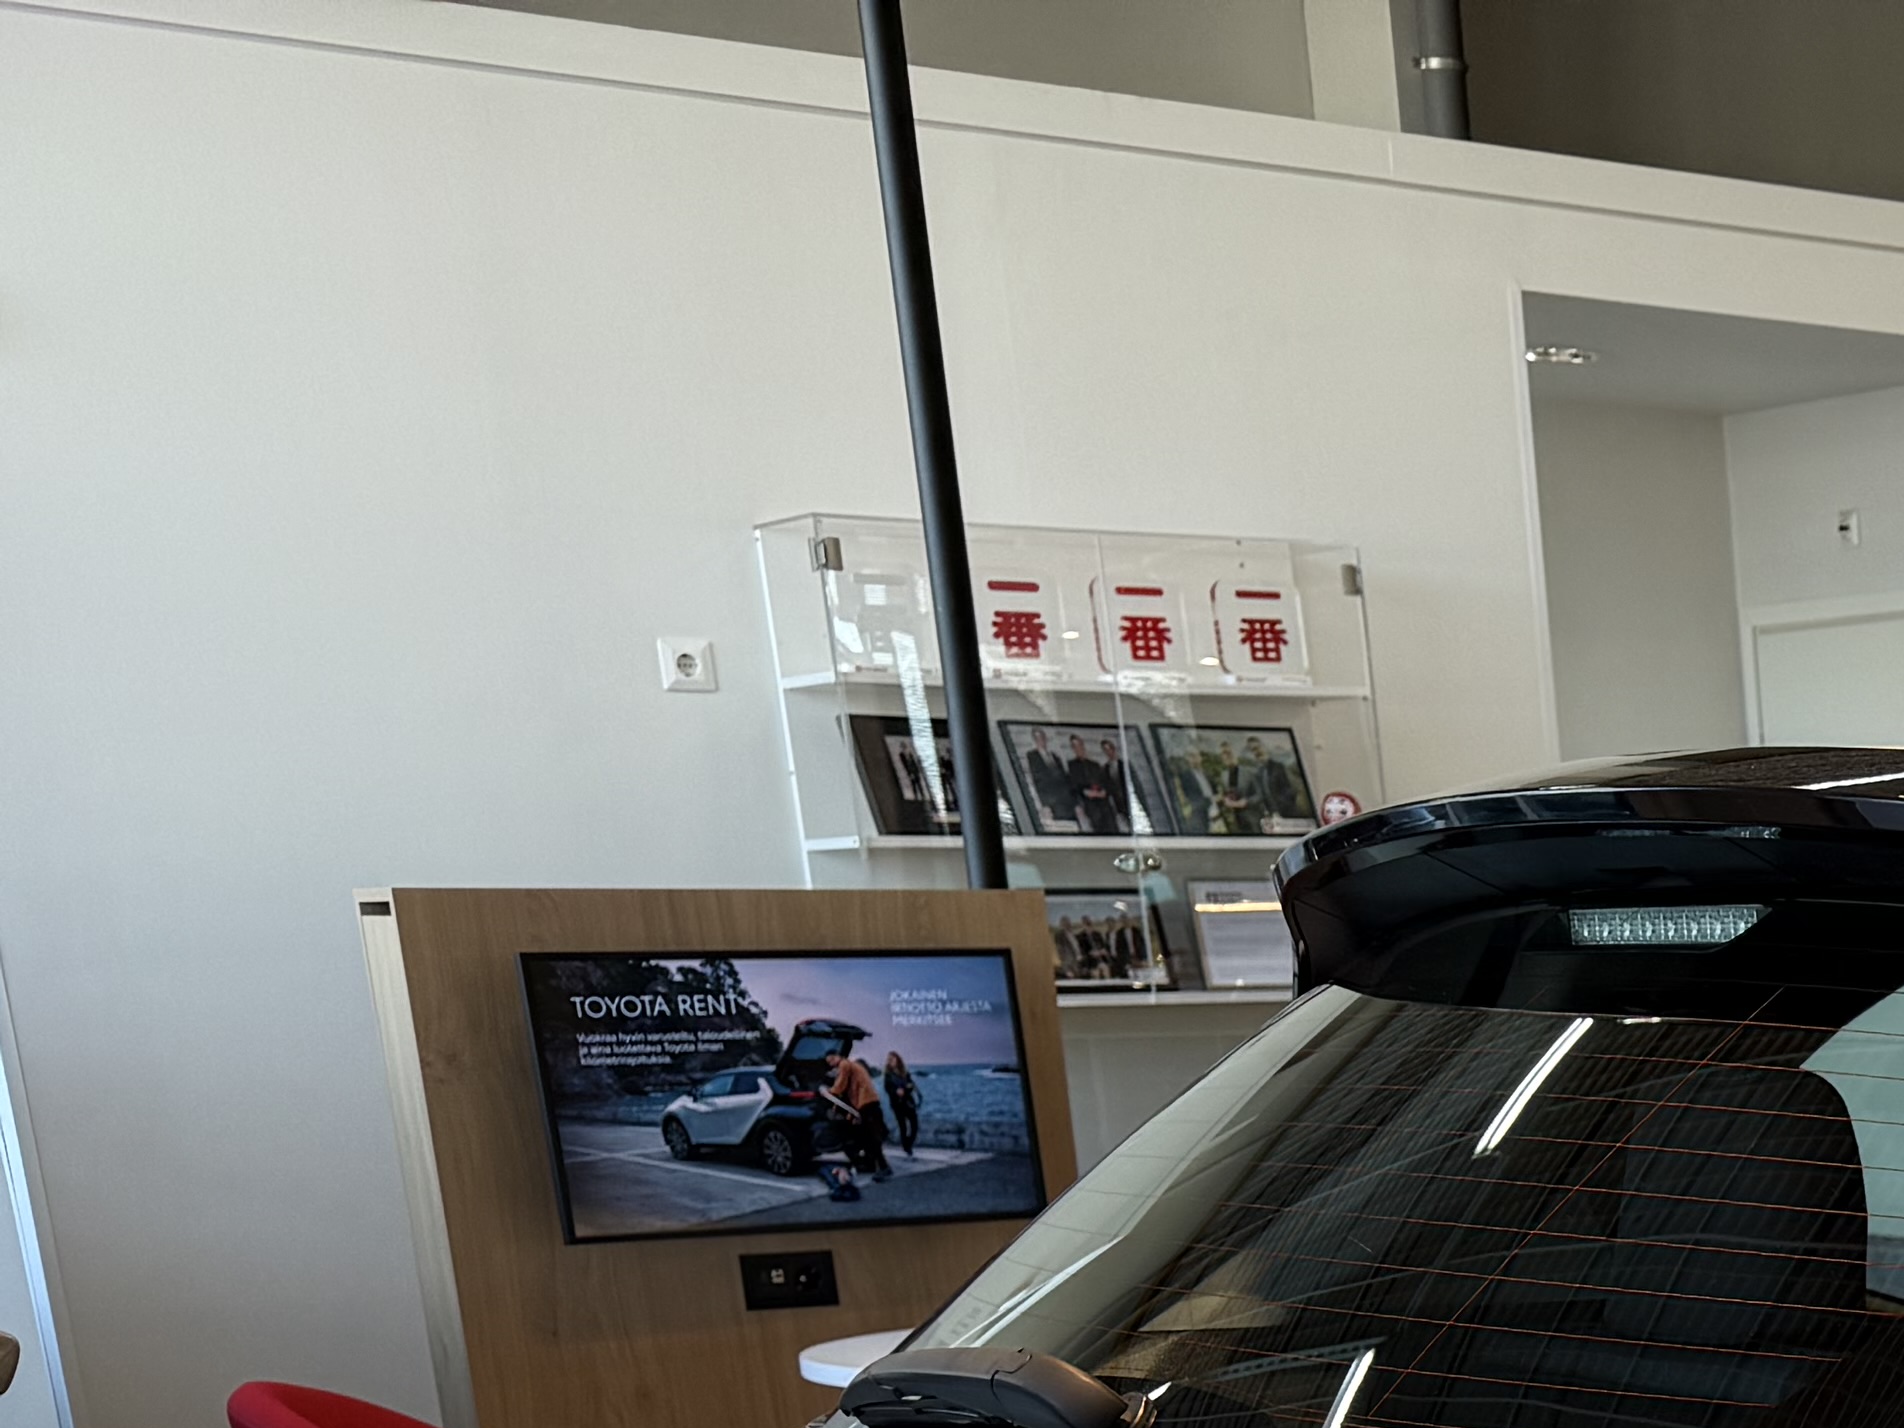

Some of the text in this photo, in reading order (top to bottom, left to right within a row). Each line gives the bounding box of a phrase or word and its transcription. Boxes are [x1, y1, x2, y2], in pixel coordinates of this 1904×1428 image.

[570, 993, 737, 1018] TOYOTA RENT
[663, 1042, 696, 1054] Toyota
